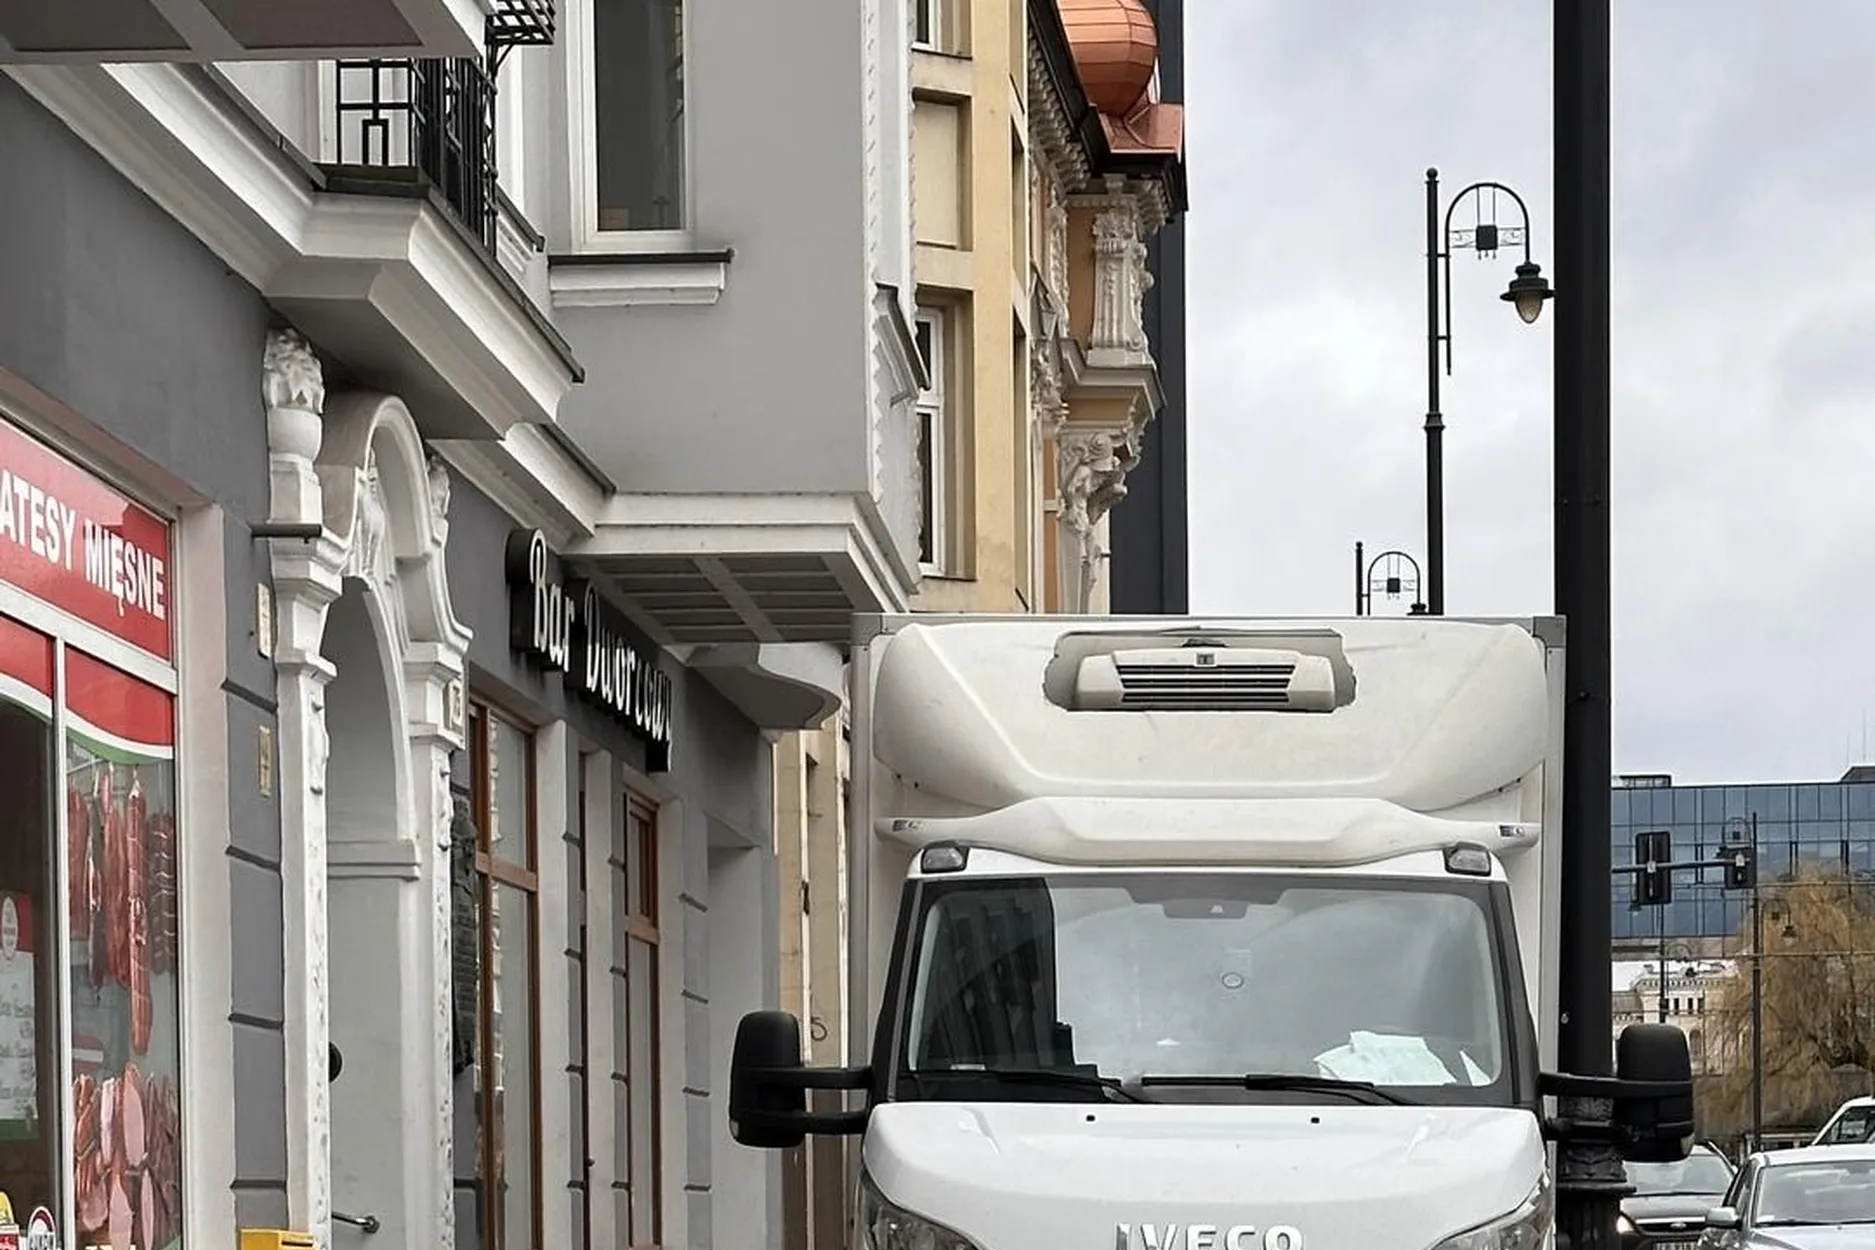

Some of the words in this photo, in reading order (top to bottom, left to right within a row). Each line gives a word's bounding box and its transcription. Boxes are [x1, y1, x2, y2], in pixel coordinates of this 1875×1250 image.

[0, 469, 77, 571] ATESY
[84, 520, 165, 620] MIĘSNE
[530, 528, 576, 673] Bar
[584, 583, 673, 773] Dworcowy
